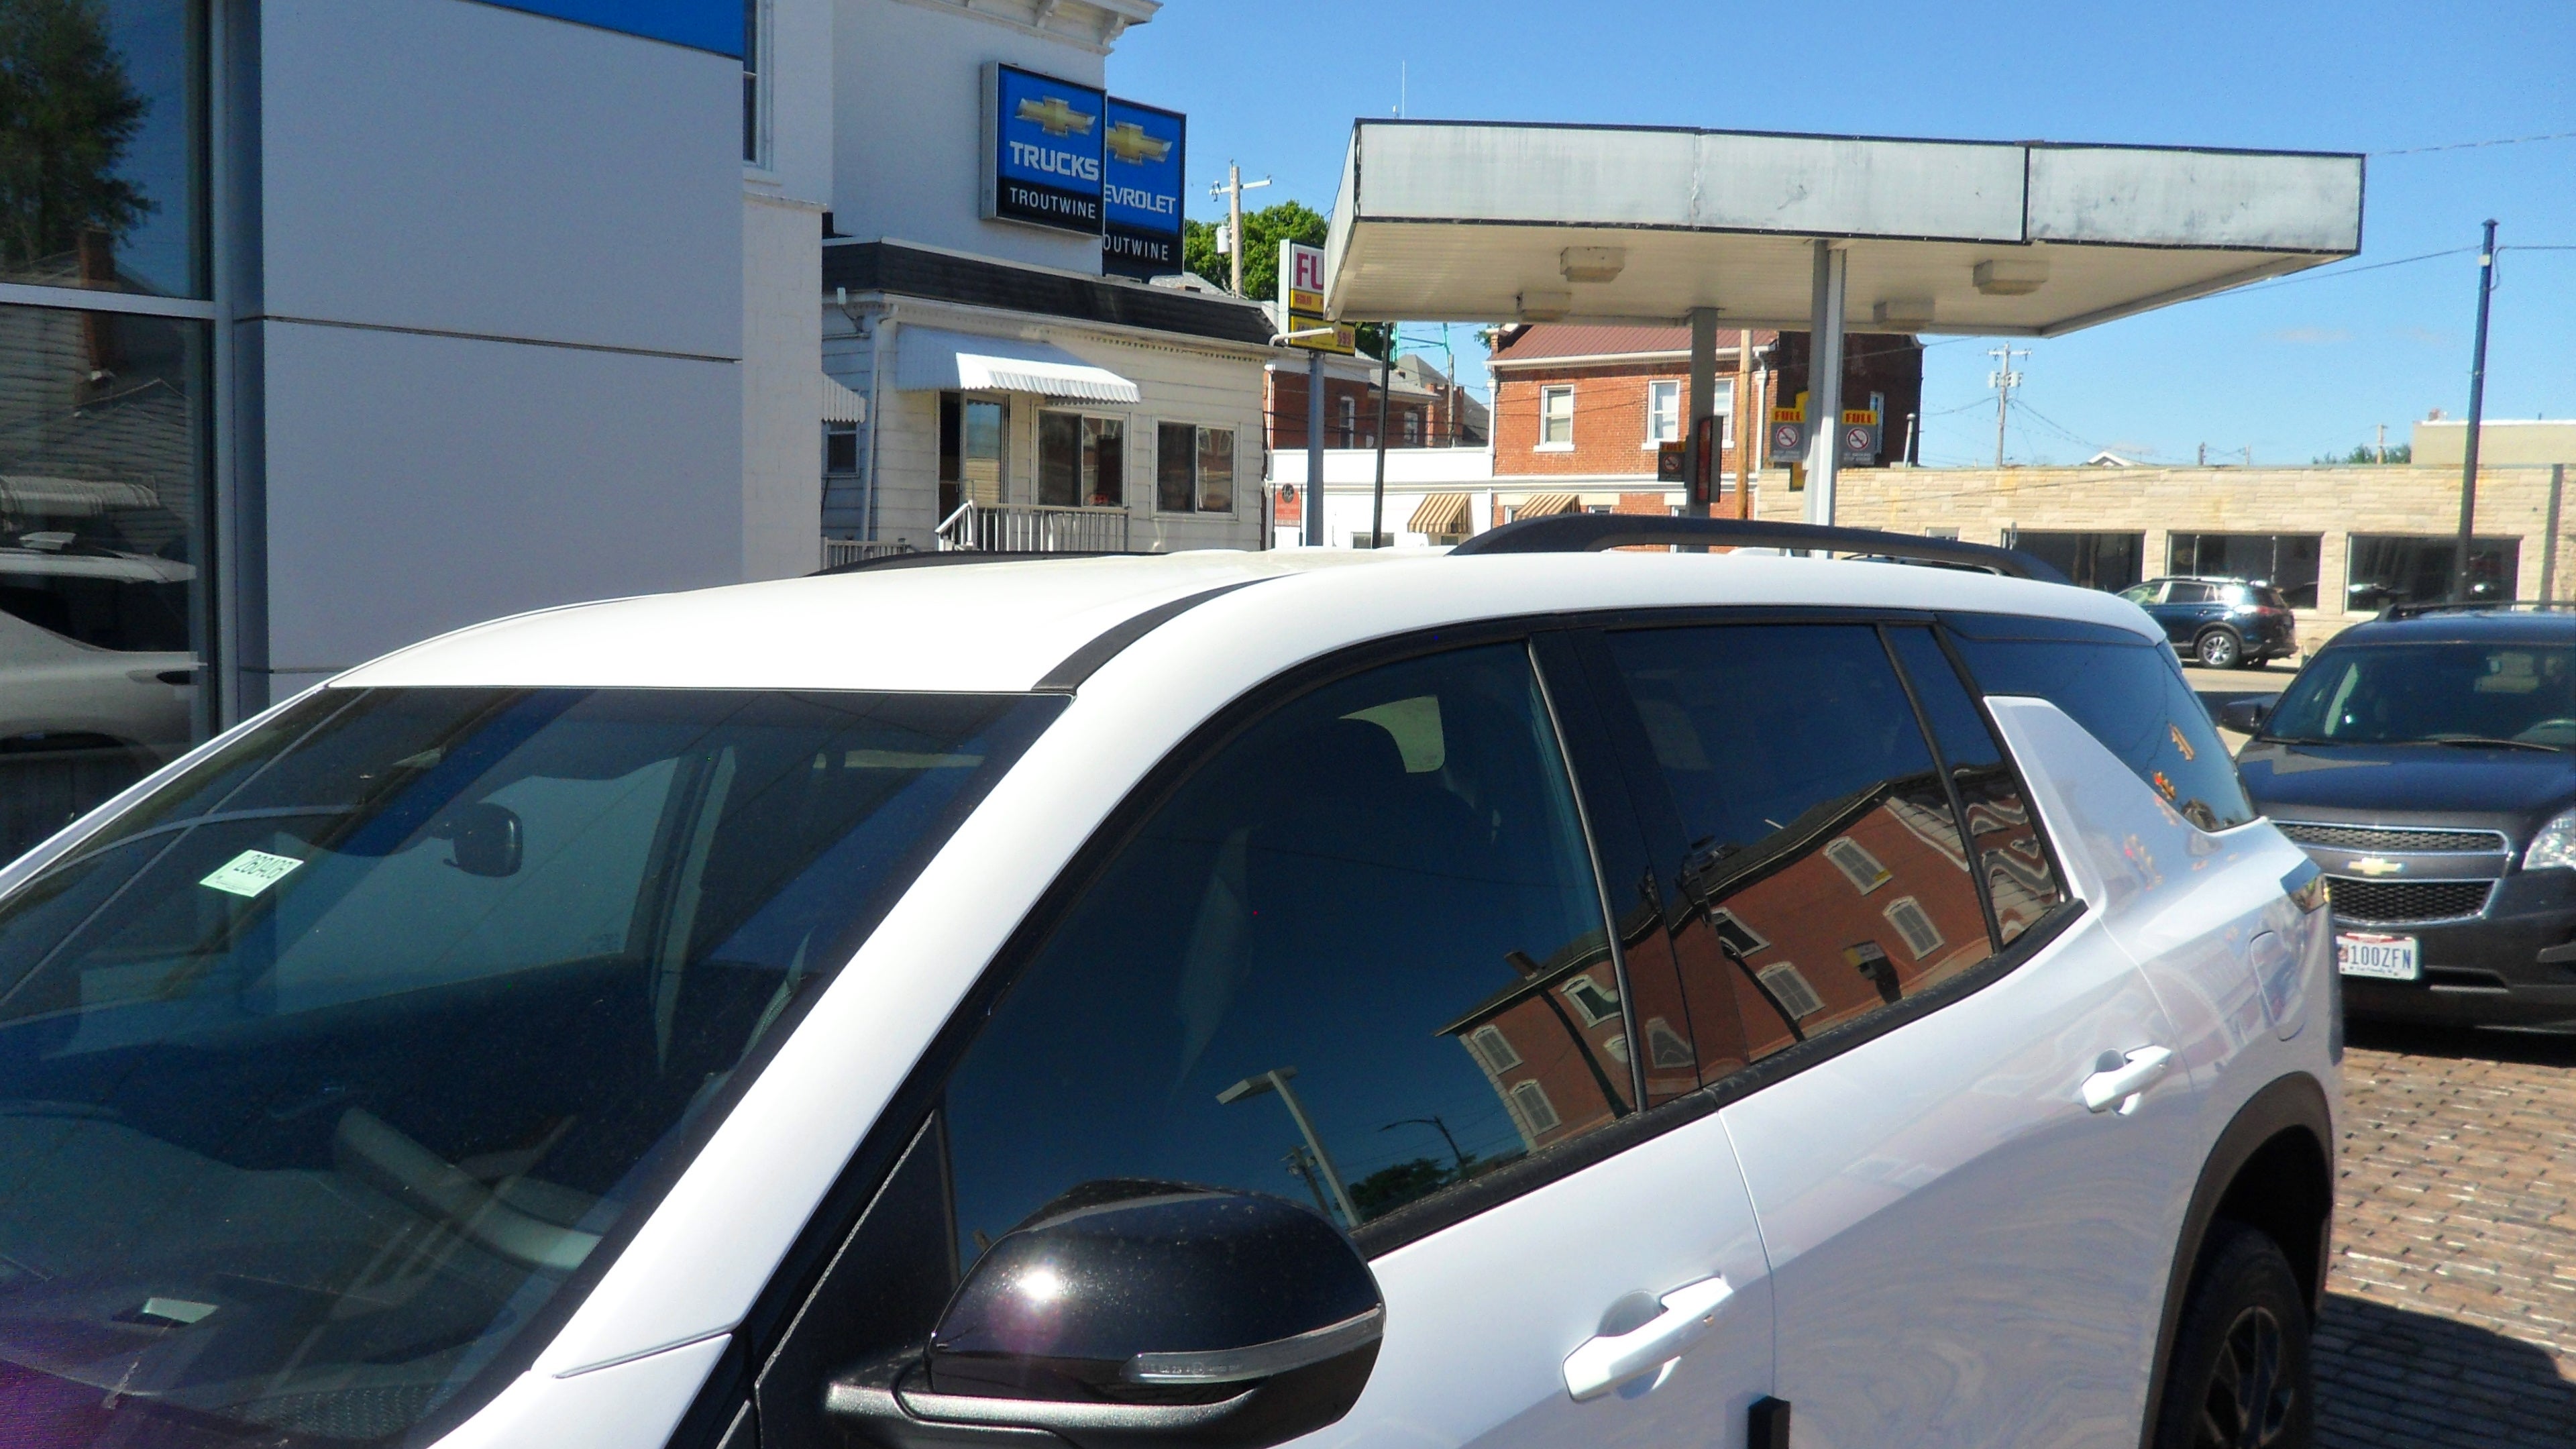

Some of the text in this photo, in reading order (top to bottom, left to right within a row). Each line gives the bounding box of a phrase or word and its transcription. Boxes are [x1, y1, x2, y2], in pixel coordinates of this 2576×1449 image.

[1010, 141, 1099, 181] TRUCKS
[1010, 187, 1096, 219] TROUTWINE
[1104, 235, 1169, 261] OUTWINE
